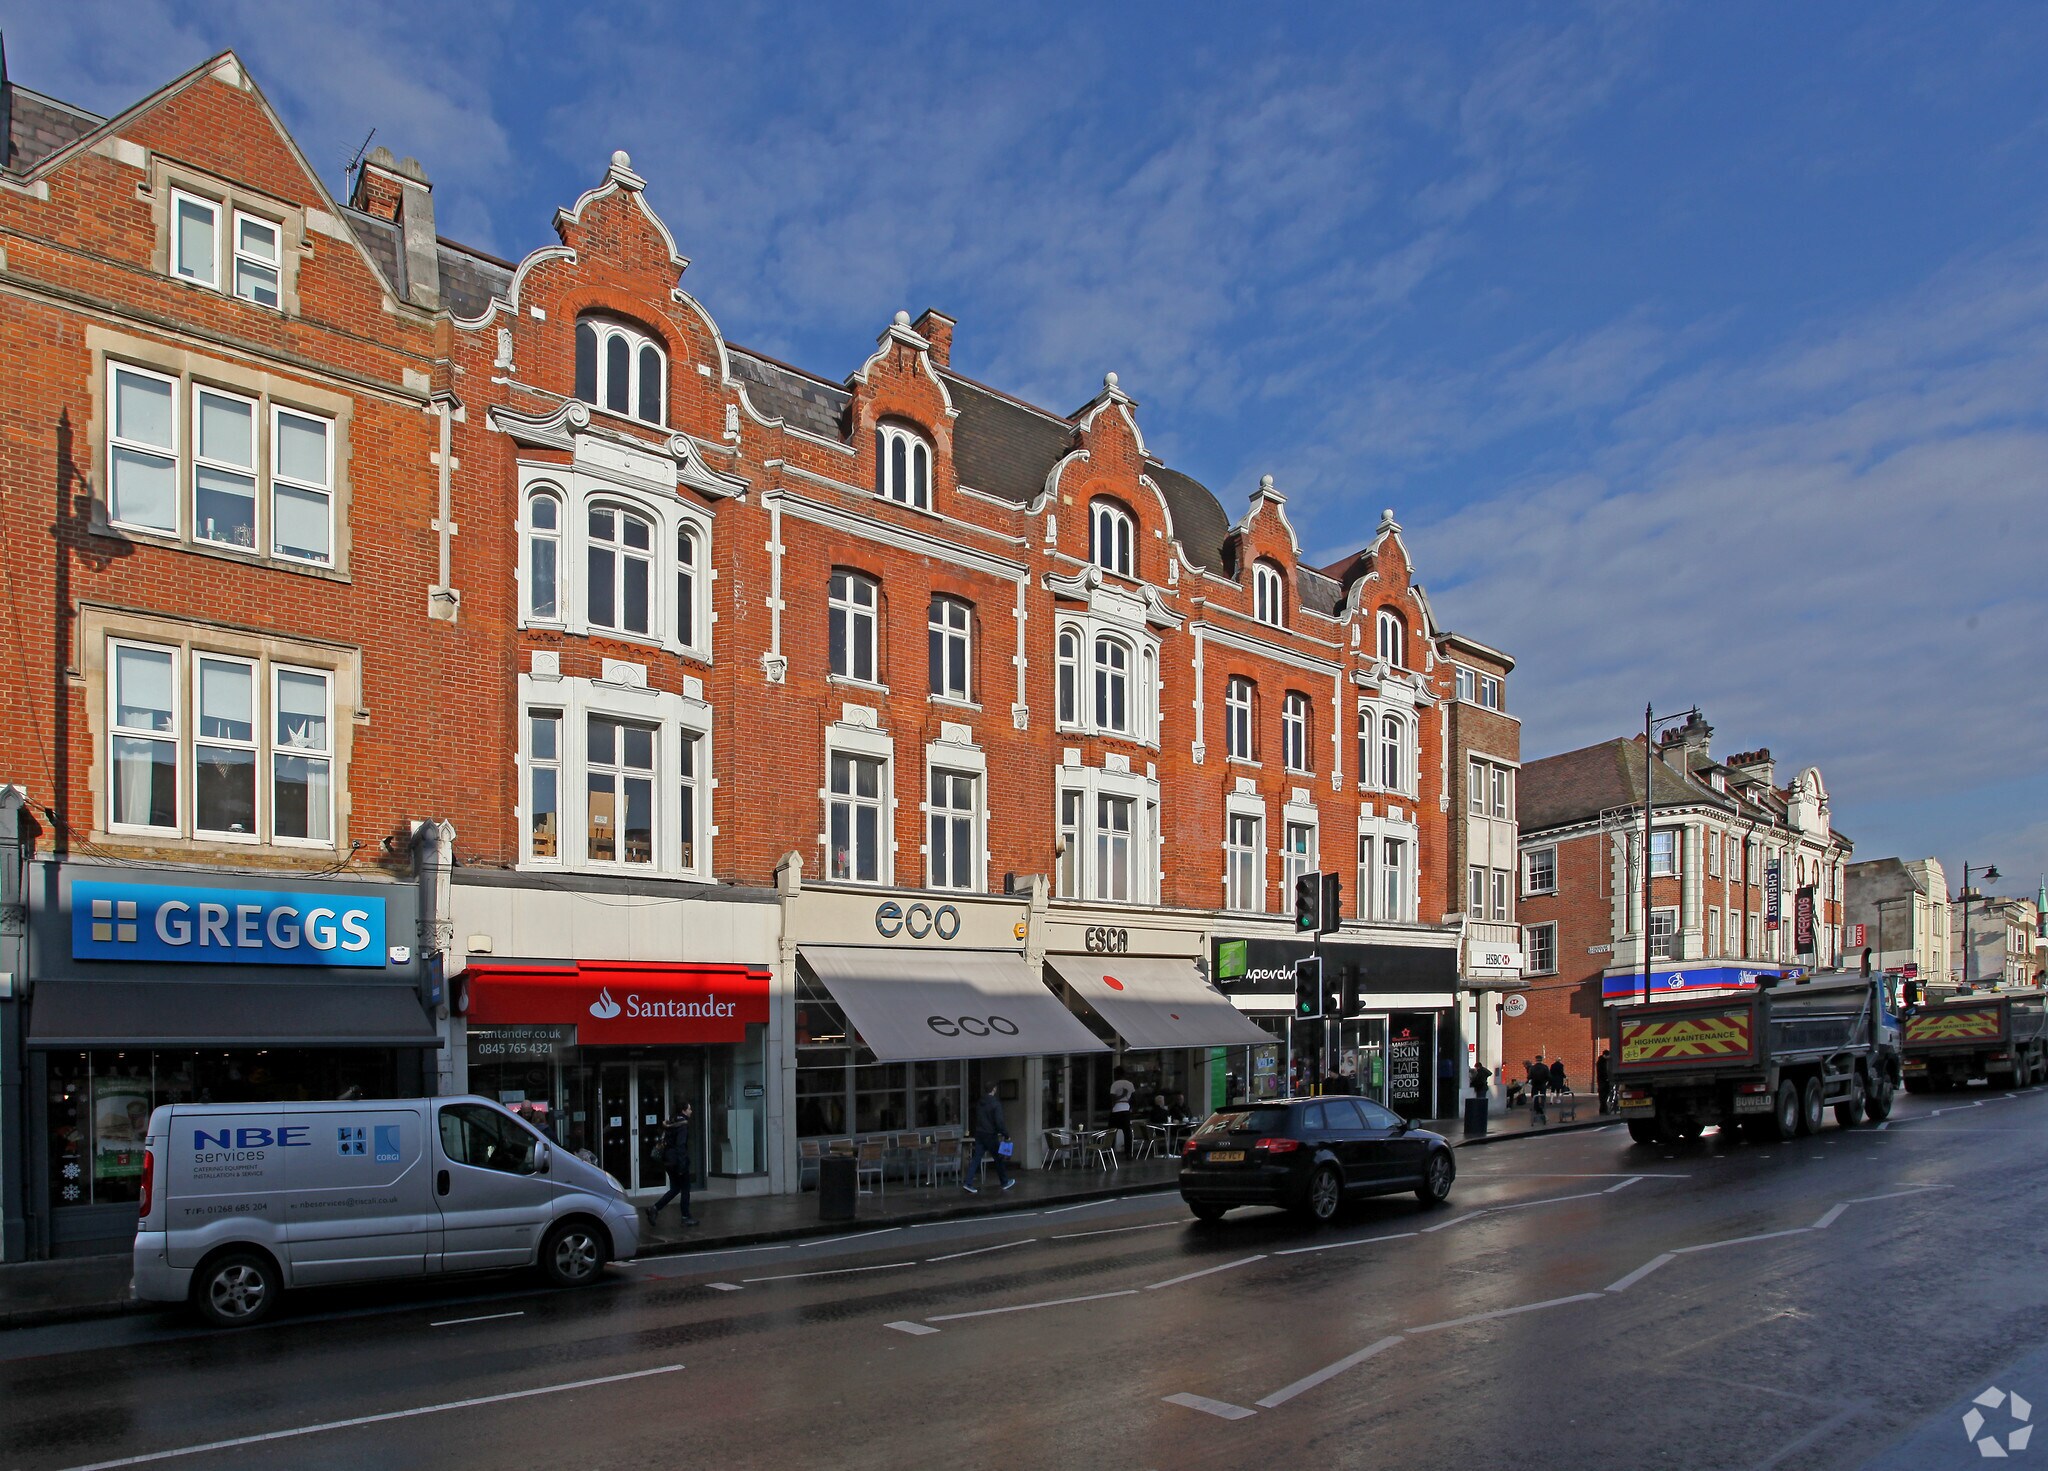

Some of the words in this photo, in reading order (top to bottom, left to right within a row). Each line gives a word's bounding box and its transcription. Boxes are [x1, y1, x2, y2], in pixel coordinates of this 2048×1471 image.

[1768, 873, 1777, 917] CHEMIST
[155, 900, 371, 952] GREGGS
[875, 901, 961, 941] eco
[1797, 897, 1812, 944] INFERNOS
[1085, 926, 1128, 953] ESCA
[1485, 953, 1502, 966] HSBC
[1245, 965, 1297, 984] uperdr
[626, 993, 736, 1018] Santander
[1505, 1004, 1524, 1012] HSBC
[927, 1016, 1019, 1037] eco
[1943, 1022, 1988, 1030] MAINTENANCE
[478, 1029, 561, 1039] santander.co.uk
[1634, 1036, 1671, 1046] HIGHWAY
[1673, 1031, 1735, 1043] MAINTENANCE
[478, 1043, 505, 1054] 0845
[508, 1043, 527, 1054] 765
[529, 1043, 553, 1054] 4321
[1393, 1047, 1419, 1058] SKIN
[1392, 1061, 1419, 1073] HAIR
[1391, 1078, 1419, 1088] FOOD
[1392, 1091, 1419, 1099] HEALTH
[194, 1126, 311, 1150] NBE
[195, 1148, 265, 1164] services
[376, 1153, 399, 1161] CORGI
[193, 1165, 224, 1173] CATERING
[207, 1205, 233, 1214] 01268
[235, 1203, 250, 1212] 685
[253, 1203, 267, 1211] 204
